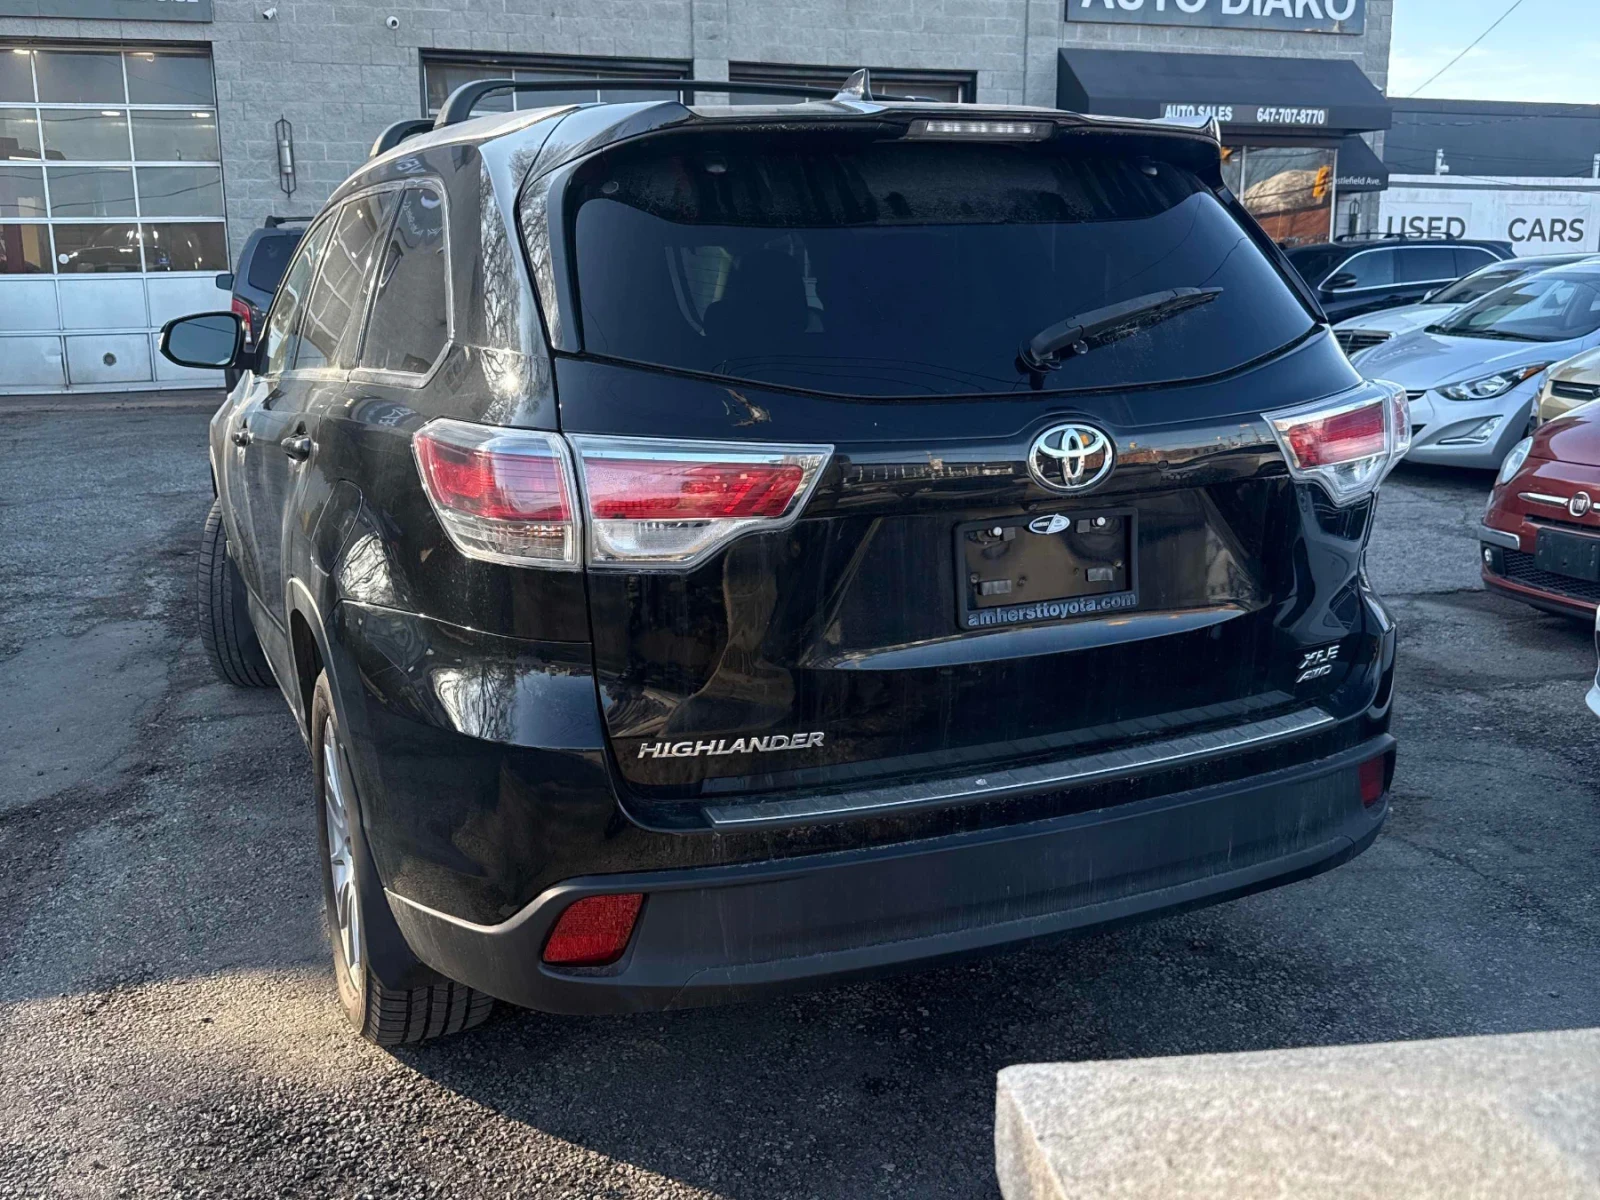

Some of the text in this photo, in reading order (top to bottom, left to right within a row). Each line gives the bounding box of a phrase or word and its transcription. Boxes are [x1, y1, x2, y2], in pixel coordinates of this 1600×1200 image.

[1164, 104, 1325, 124] AUTO SALES 647-707-8770
[1366, 176, 1381, 185] Ave.
[1387, 216, 1584, 242] USED CARS
[968, 593, 1137, 627] amhersttoyota.com
[637, 731, 825, 759] HIGHLANDER
